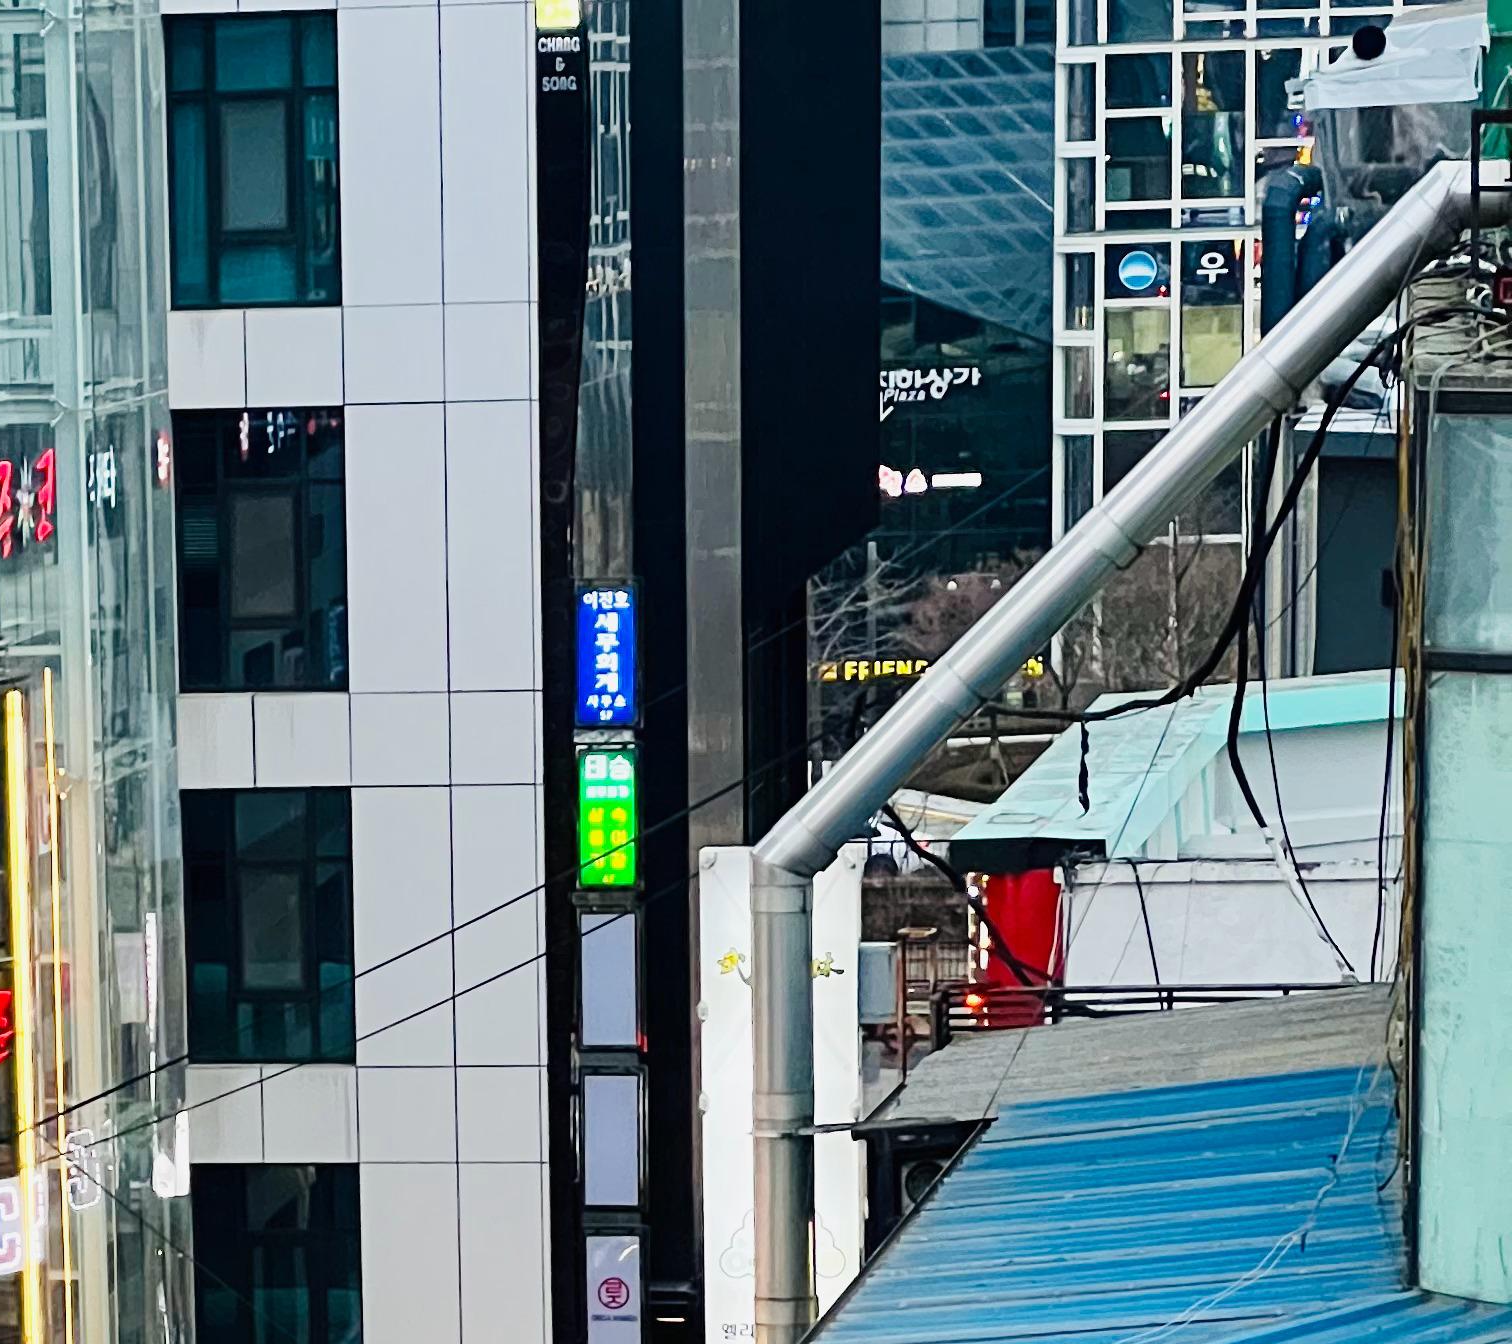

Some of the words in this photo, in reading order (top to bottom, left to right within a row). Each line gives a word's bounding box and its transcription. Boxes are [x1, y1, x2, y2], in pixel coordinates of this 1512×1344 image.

[538, 37, 580, 52] CHANG
[542, 76, 576, 91] SONG
[1196, 252, 1229, 284] 우
